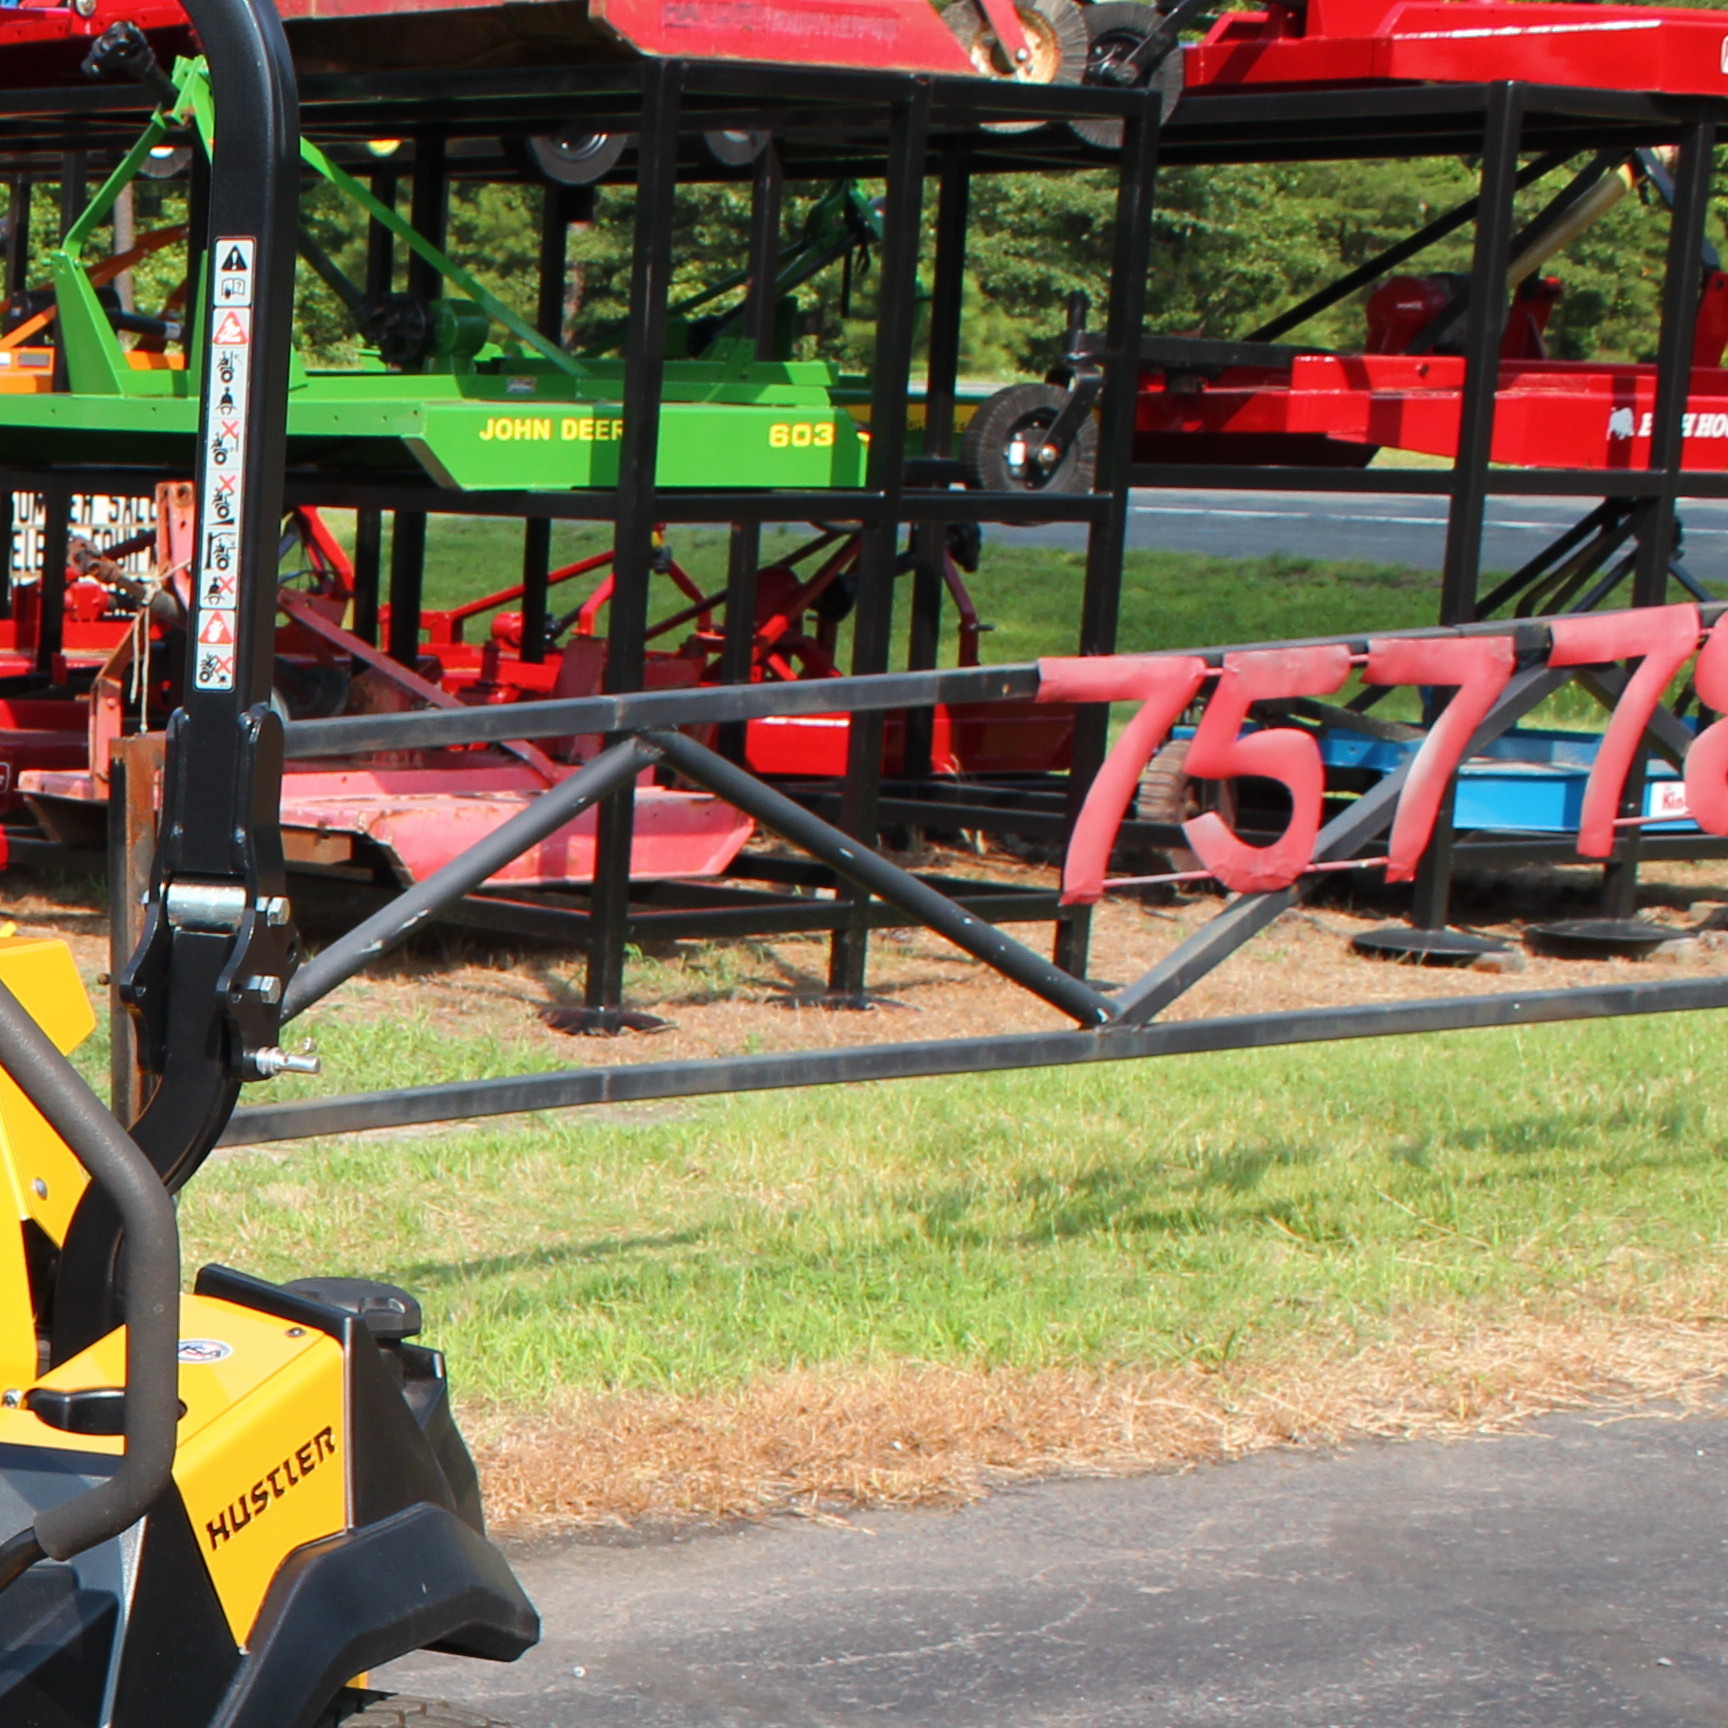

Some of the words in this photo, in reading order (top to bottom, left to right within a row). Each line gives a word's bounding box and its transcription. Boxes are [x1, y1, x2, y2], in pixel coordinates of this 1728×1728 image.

[478, 418, 552, 441] JOHN
[560, 418, 624, 441] DEER
[768, 422, 836, 448] 603
[205, 1425, 336, 1551] HUSTLER
